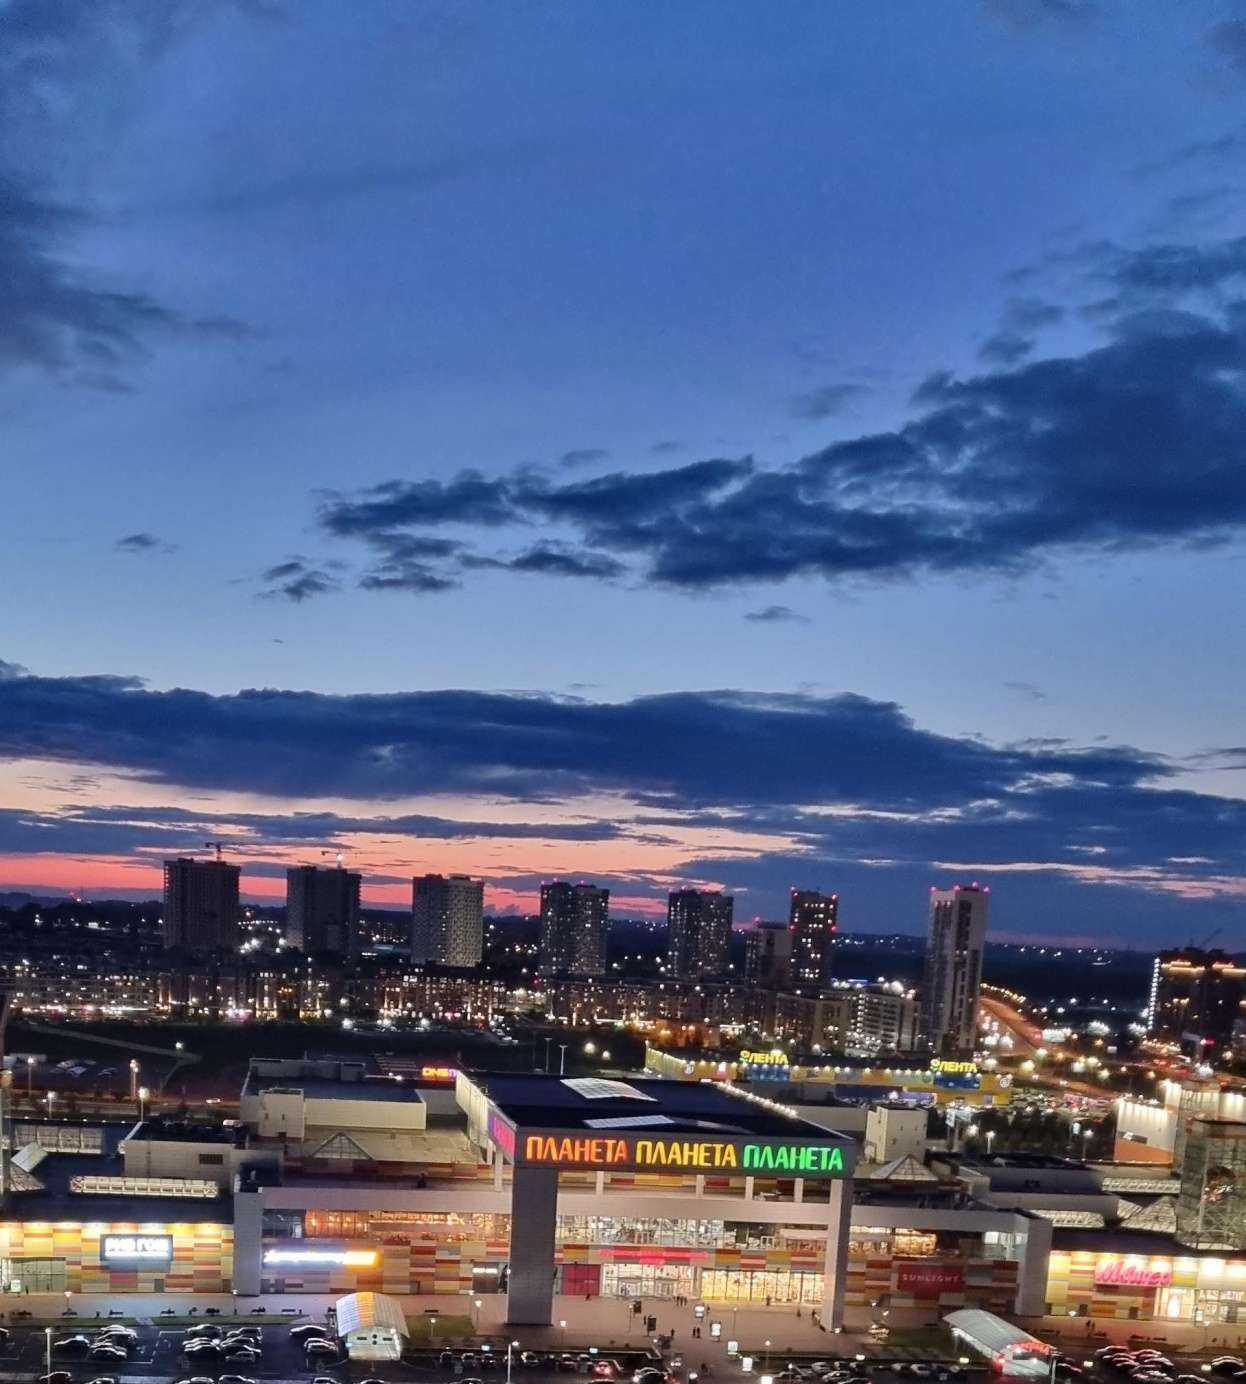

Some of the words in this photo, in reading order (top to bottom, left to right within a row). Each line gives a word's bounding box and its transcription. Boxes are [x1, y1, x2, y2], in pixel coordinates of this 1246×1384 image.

[748, 1052, 788, 1065] ЛЕНТА
[940, 1061, 977, 1073] ЛЕНТА
[526, 1136, 628, 1163] ПЛАНЕТА
[635, 1140, 737, 1167] ПЛАНЕТА
[743, 1144, 843, 1171] ПЛАНЕТА
